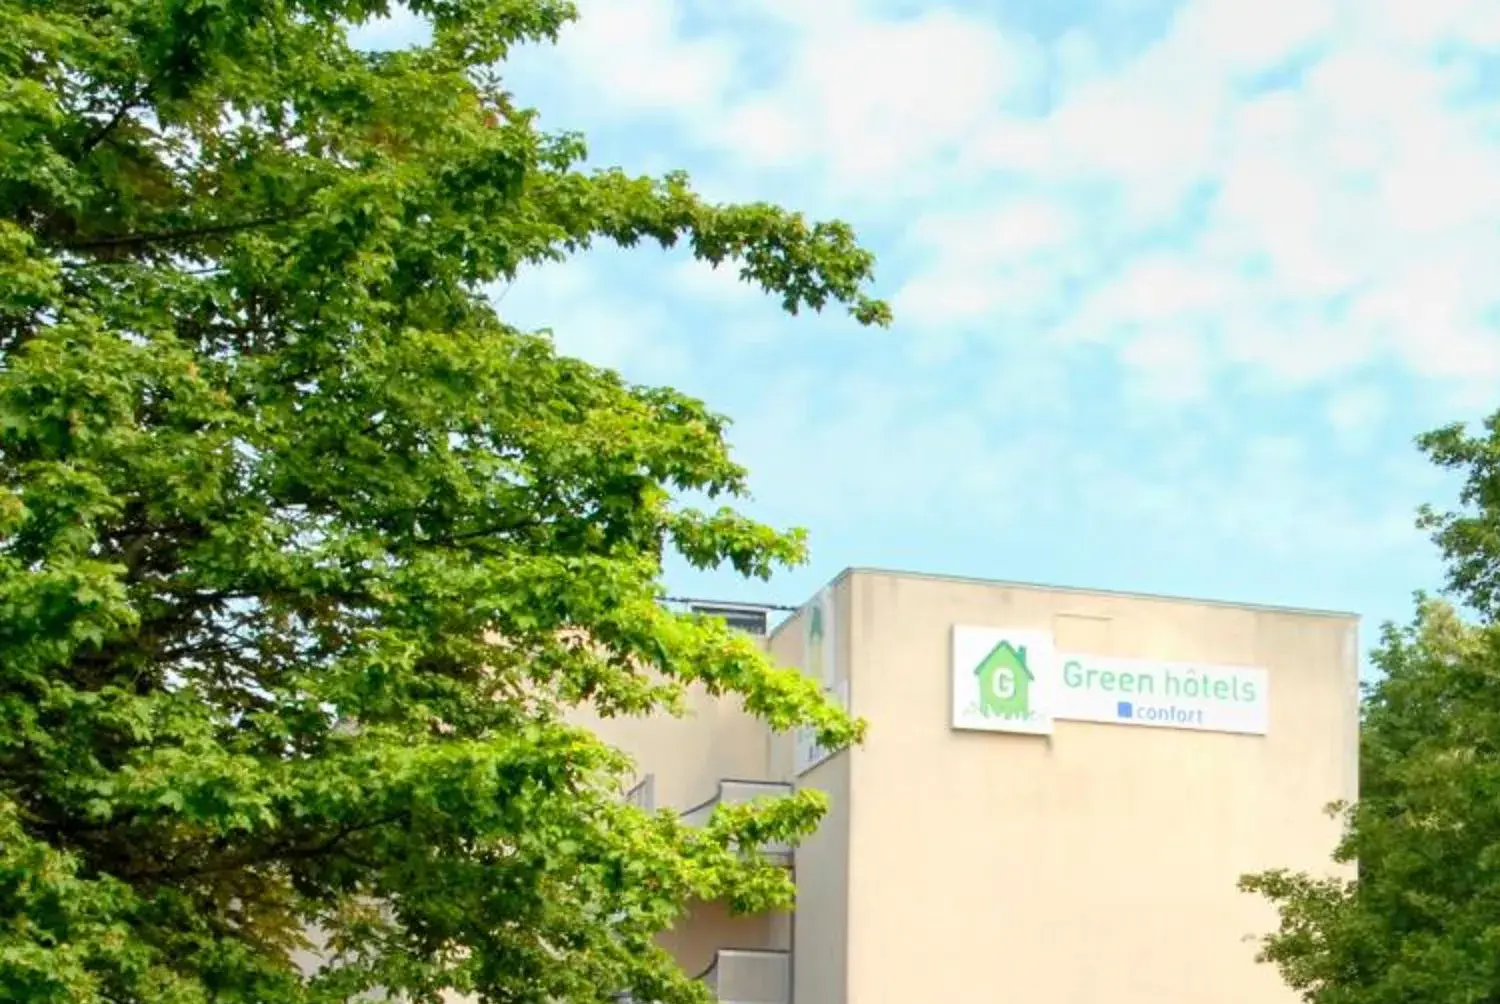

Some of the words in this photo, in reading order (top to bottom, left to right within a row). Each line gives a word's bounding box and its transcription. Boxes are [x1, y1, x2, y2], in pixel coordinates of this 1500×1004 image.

[1063, 660, 1154, 694] Green
[1165, 667, 1256, 702] hôtels
[1137, 704, 1203, 722] confort
